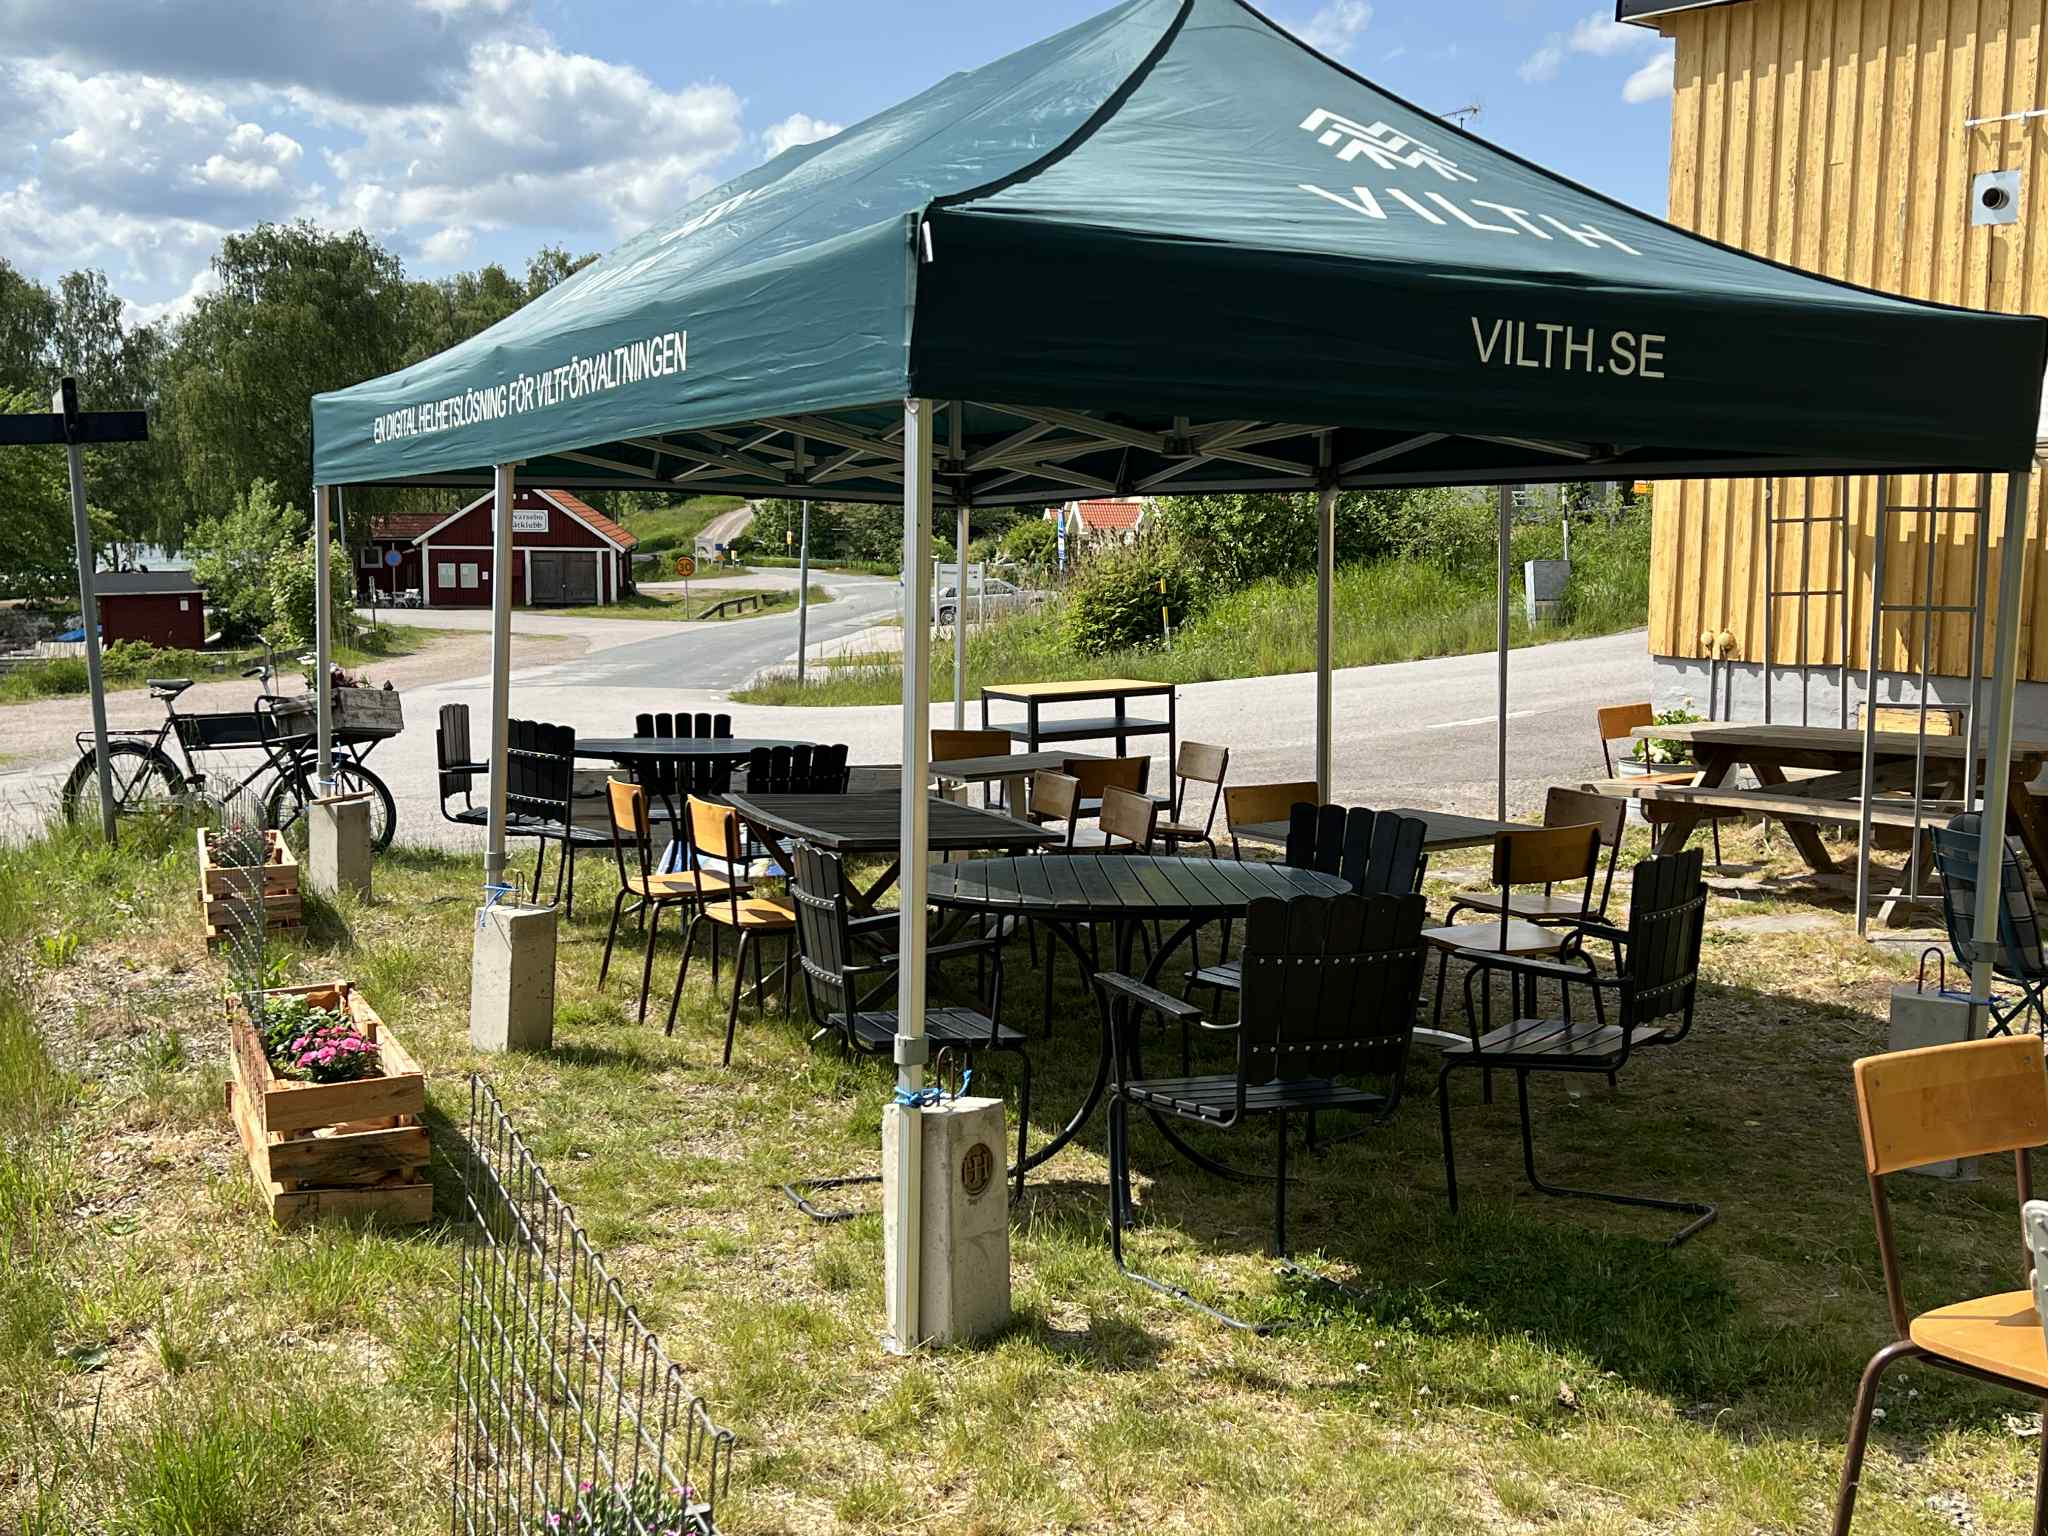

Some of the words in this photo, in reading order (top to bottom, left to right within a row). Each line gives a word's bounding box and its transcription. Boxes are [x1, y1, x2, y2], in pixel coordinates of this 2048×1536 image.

[1297, 183, 1643, 256] VILTH
[1471, 315, 1667, 381] VILTH.SE
[373, 415, 386, 445] EN
[386, 406, 418, 441] DIGITAL
[418, 384, 507, 433] HELHETSLÖSNING
[508, 373, 535, 416] FÖR
[536, 330, 688, 408] VILTFÖRVALTNINGEN
